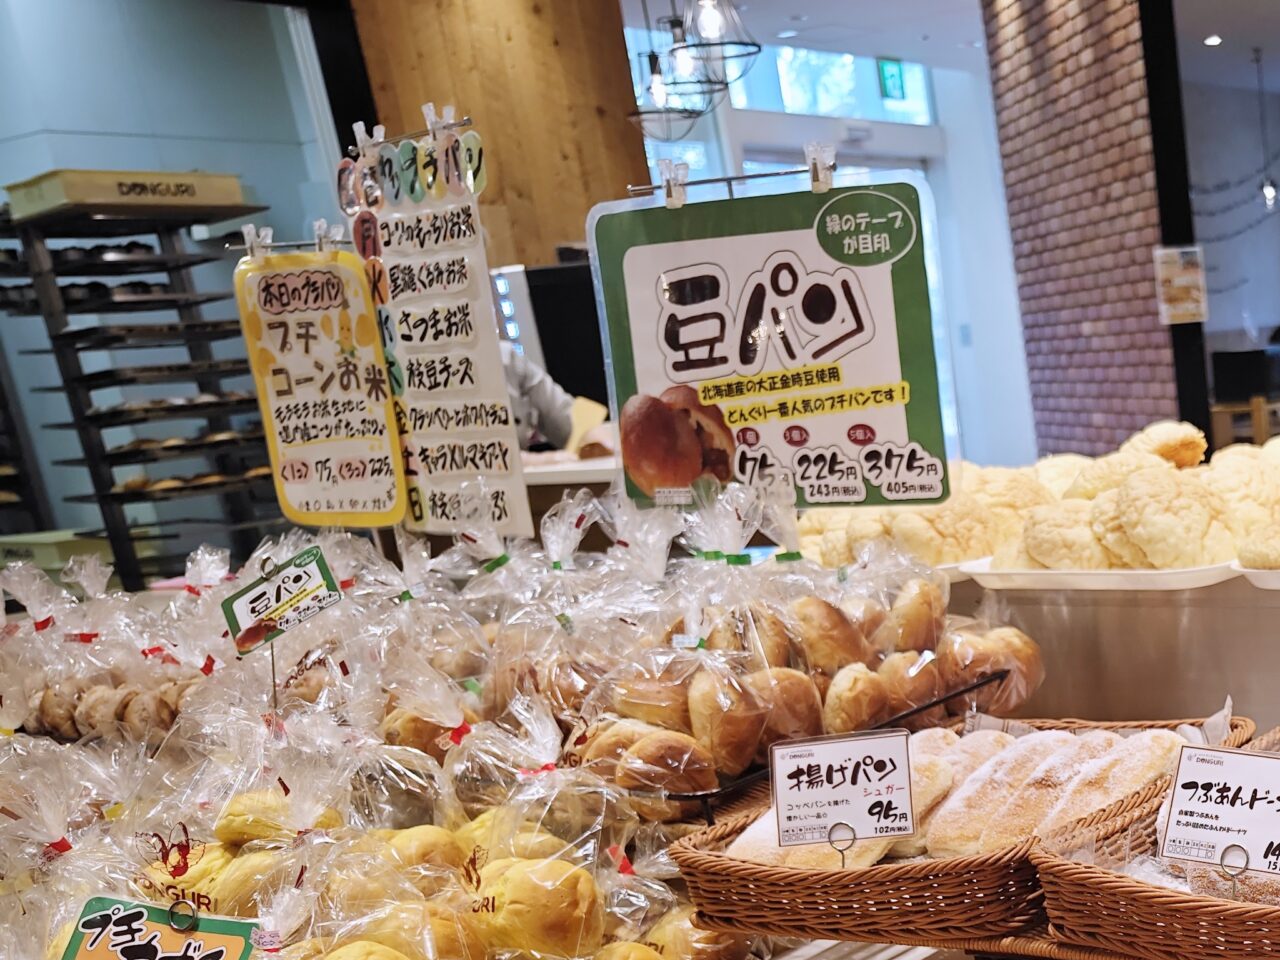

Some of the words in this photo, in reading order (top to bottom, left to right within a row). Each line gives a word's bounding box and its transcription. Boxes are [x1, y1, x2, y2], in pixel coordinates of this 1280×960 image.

[826, 211, 904, 234] 緑のテープ
[843, 233, 891, 255] が目印
[664, 262, 865, 373] 豆パン
[267, 321, 317, 353] プチ
[701, 366, 841, 401] 北海道産の大正金時豆使用
[797, 451, 857, 481] 225円
[864, 448, 938, 480] 375円
[249, 570, 312, 618] 豆パン
[787, 755, 897, 792] 揚げパン
[864, 784, 905, 798] シュガー
[868, 800, 908, 823] 95円
[81, 907, 146, 948] プチ
